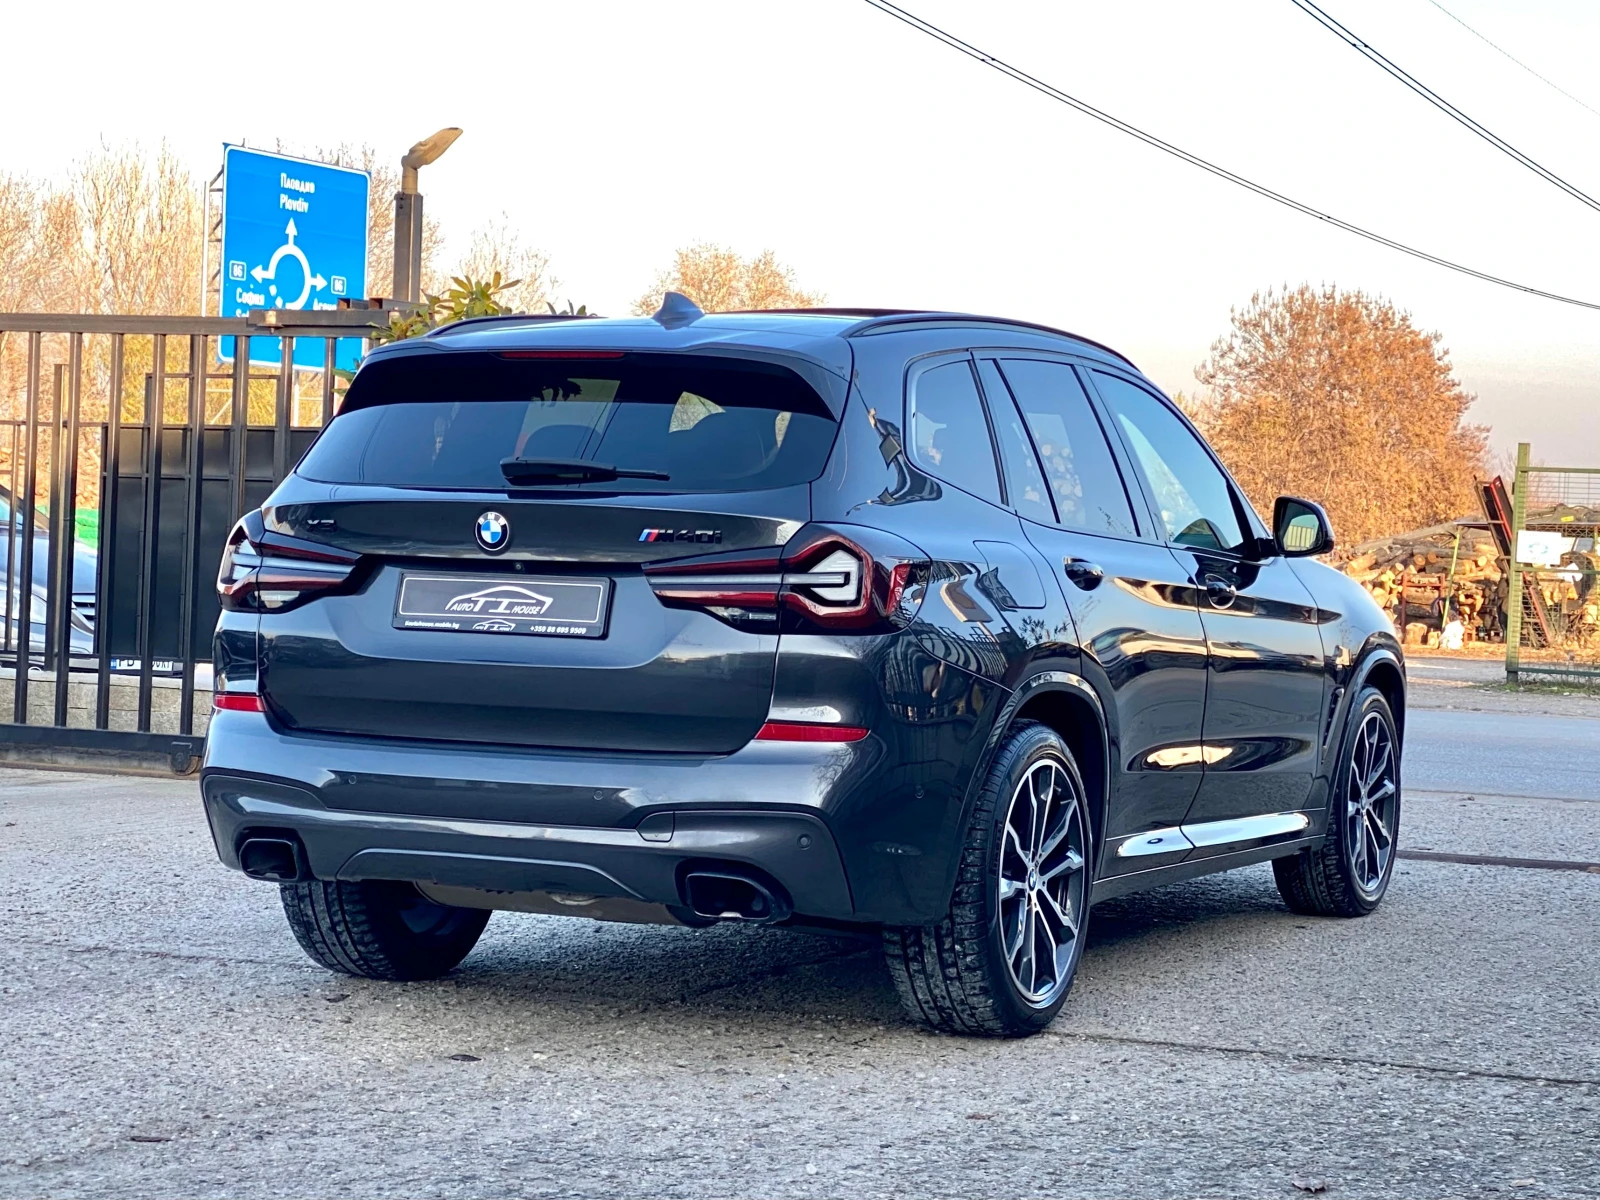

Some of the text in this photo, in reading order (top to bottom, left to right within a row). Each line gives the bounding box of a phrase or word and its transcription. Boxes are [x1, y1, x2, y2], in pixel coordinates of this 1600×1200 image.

[280, 172, 316, 194] Пловдив
[279, 193, 309, 213] Plovdiv
[235, 287, 265, 306] София
[450, 603, 474, 612] AUTO
[511, 605, 541, 615] HOUSE
